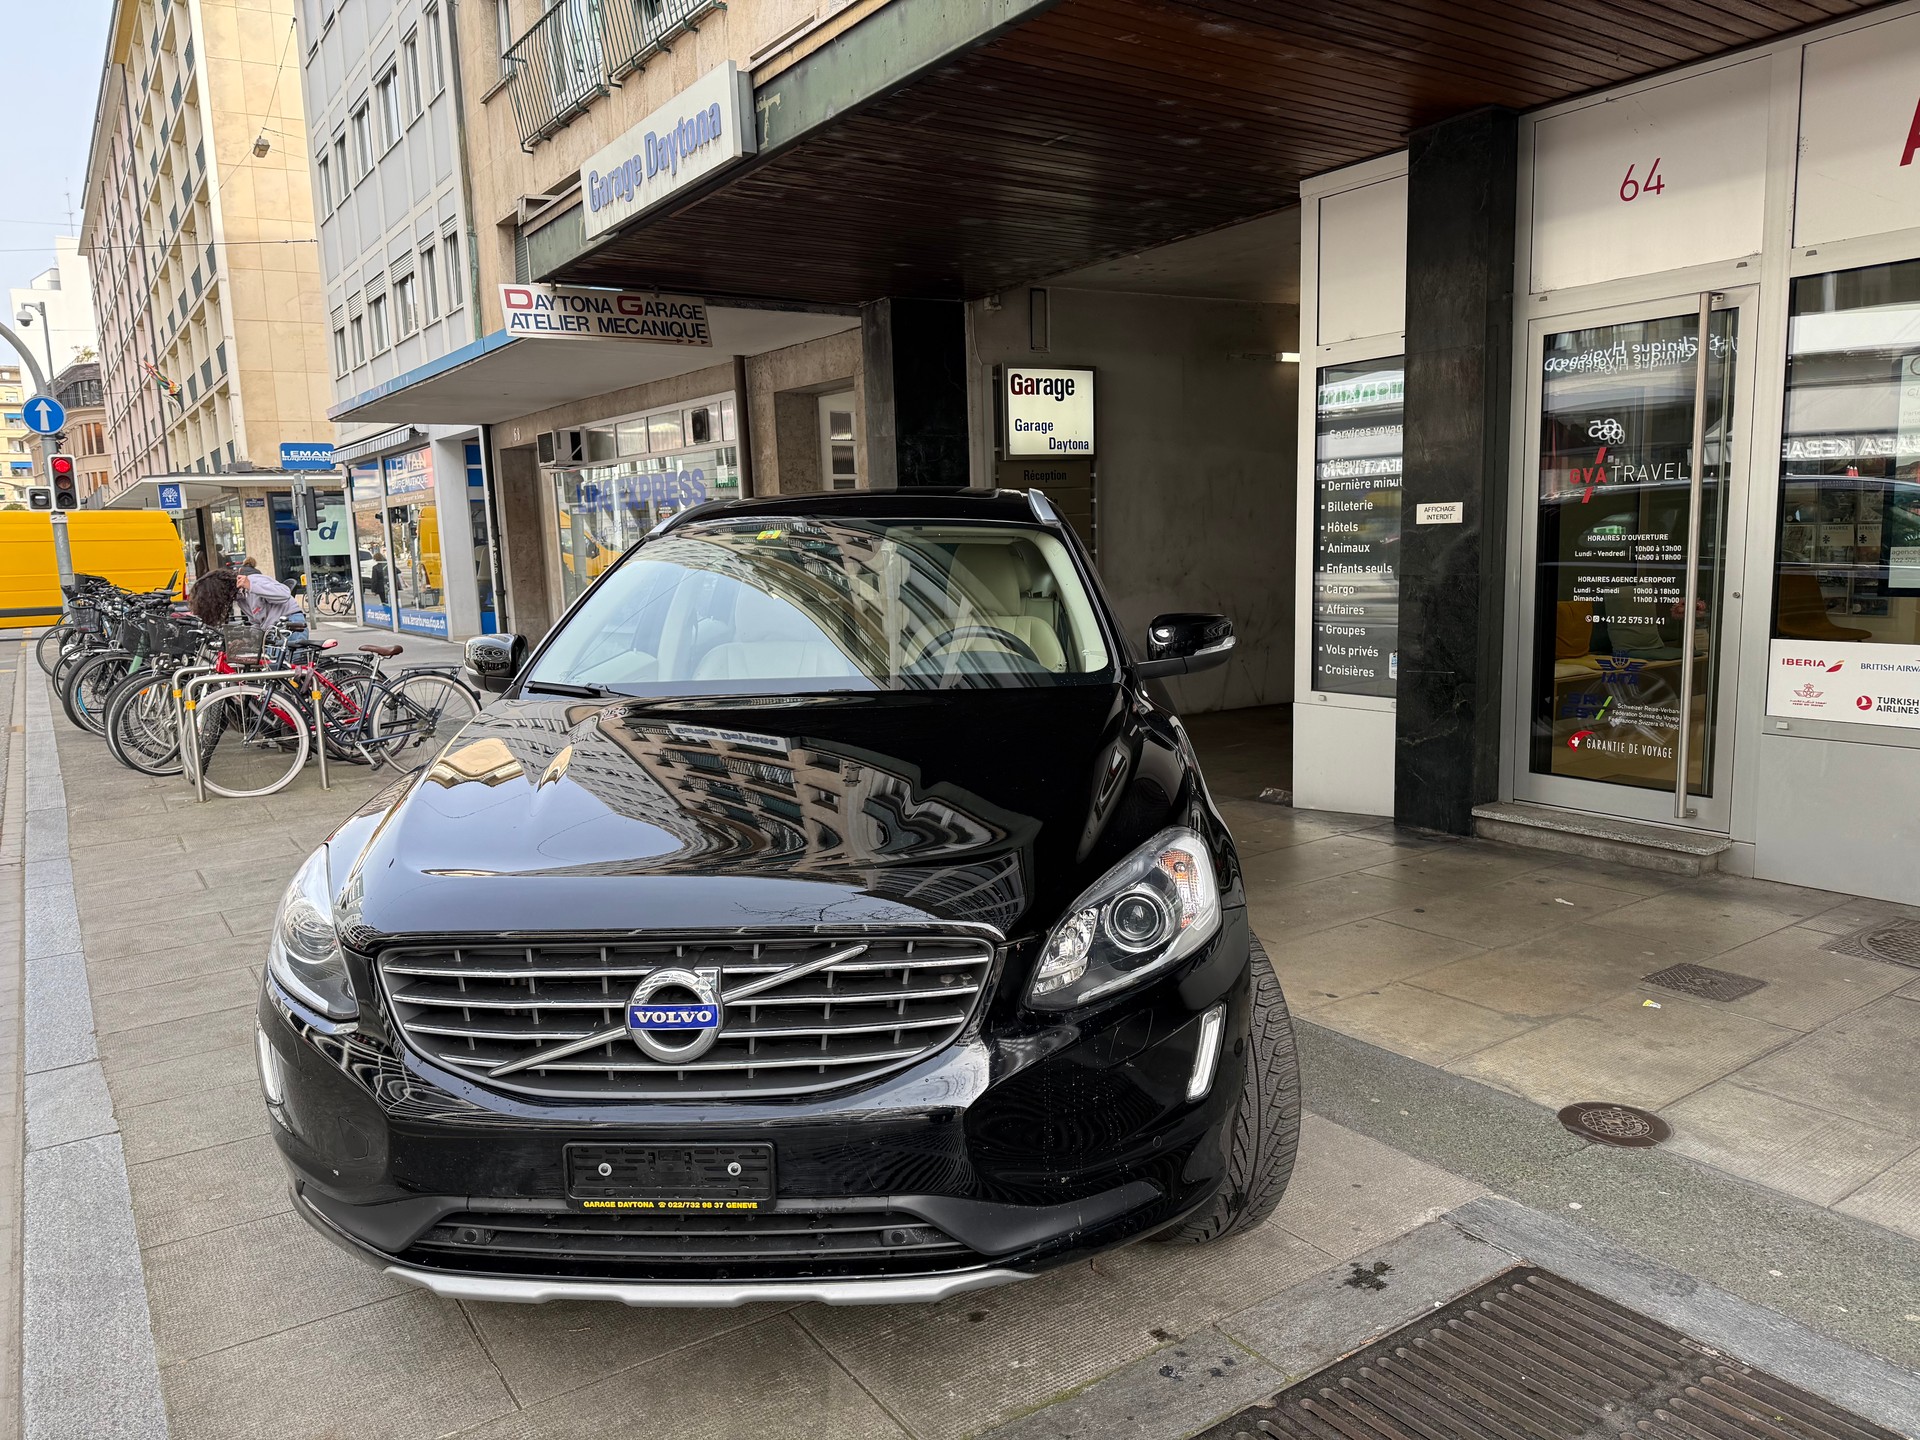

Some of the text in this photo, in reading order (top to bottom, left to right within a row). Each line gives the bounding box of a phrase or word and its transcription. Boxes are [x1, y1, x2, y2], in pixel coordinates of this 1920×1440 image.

[588, 102, 722, 213] Garage Daytona
[1619, 157, 1665, 202] 64
[510, 312, 709, 339] ATELIER MECANIQUE
[1010, 373, 1075, 402] Garage
[1014, 418, 1054, 435] Garage
[1048, 437, 1089, 453] Daytona
[1023, 469, 1067, 483] Réception
[1570, 462, 1688, 484] GVA TRAVEL
[1328, 478, 1370, 491] Dernière
[1328, 500, 1374, 512] Billeterie
[1327, 522, 1358, 532] Hôtels
[1328, 543, 1370, 553] Animaux
[1326, 563, 1392, 574] Enfants seuls
[1326, 584, 1354, 596] Cargo
[1326, 604, 1364, 615] Affaires
[1326, 624, 1366, 637] Groupes
[1326, 644, 1378, 657] Vols privés
[1782, 658, 1826, 667] IBERIA
[1860, 663, 1920, 672] BRITISH AIRW
[1326, 664, 1374, 677] Croisières
[1878, 696, 1920, 706] TURKISH
[1876, 705, 1919, 715] AIRLINES
[1586, 738, 1672, 759] GARANTIE DE VOYAGE
[634, 1010, 712, 1023] VOLVO
